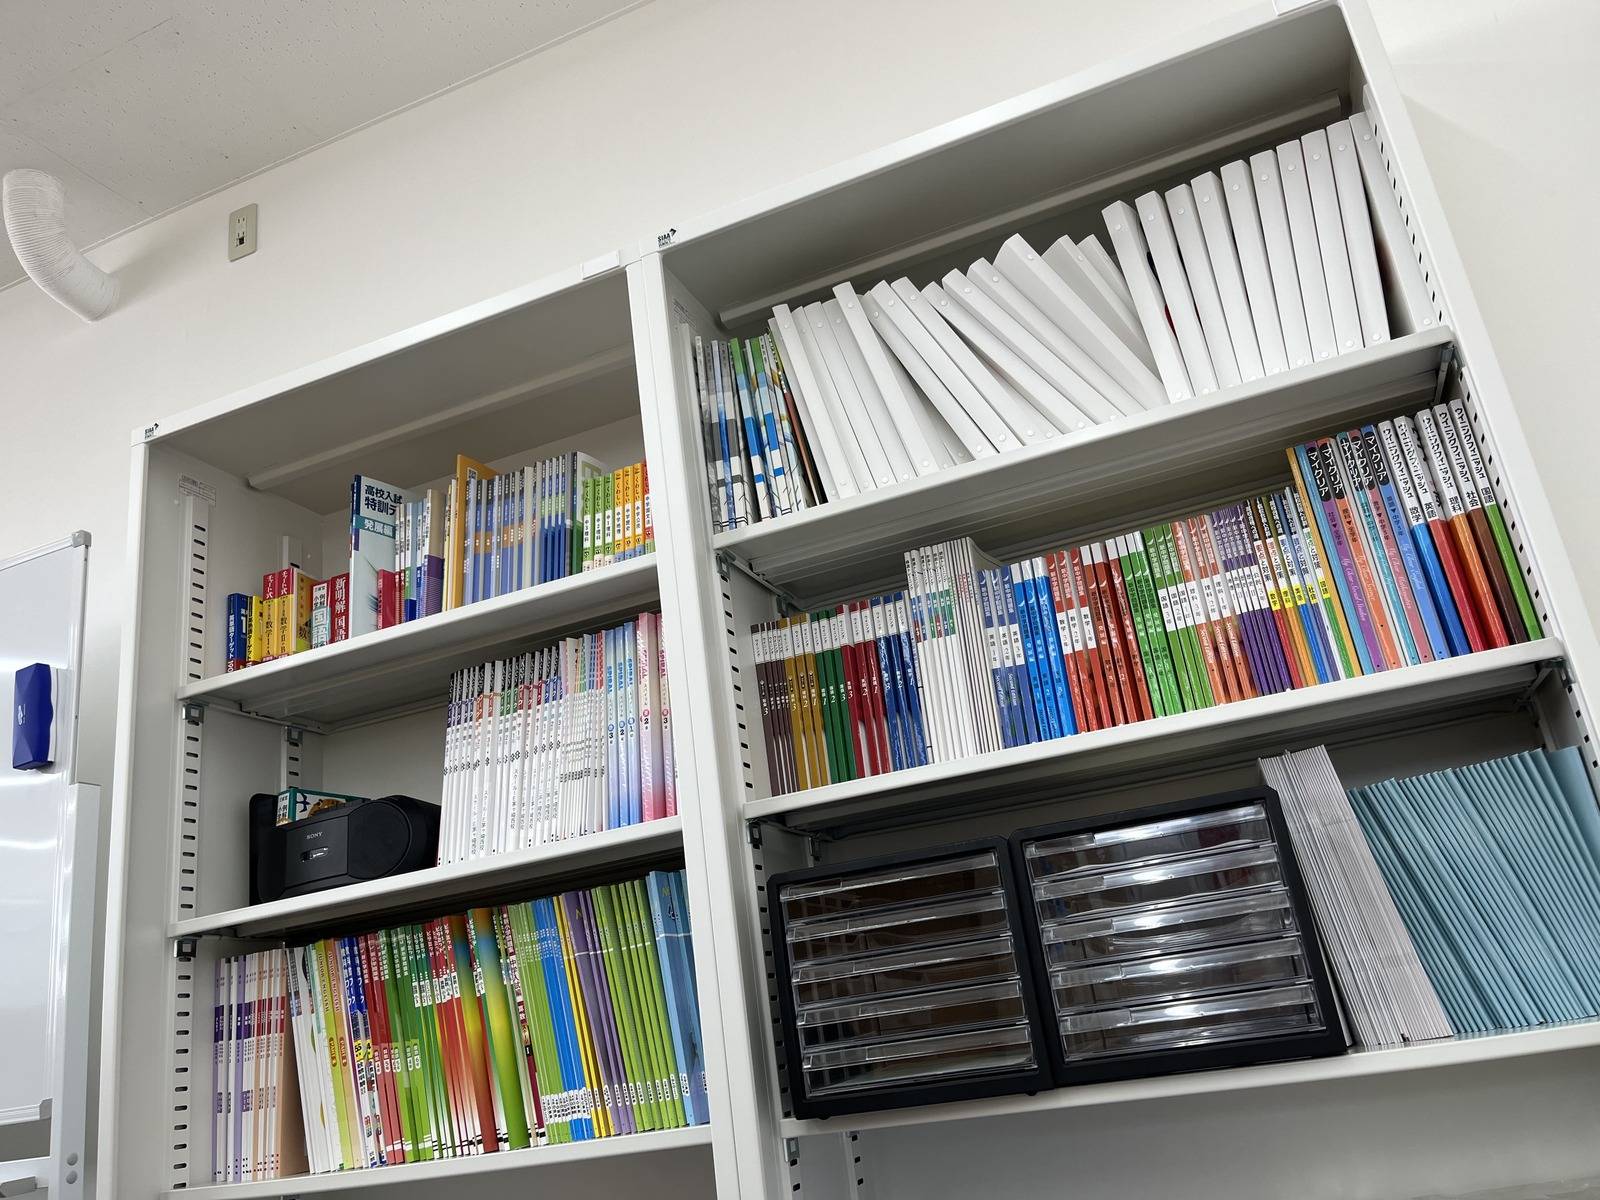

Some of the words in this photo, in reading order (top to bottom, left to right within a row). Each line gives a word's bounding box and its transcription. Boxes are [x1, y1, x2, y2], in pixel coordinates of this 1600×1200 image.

[1351, 438, 1372, 485] マイクリア
[1365, 434, 1387, 481] マイクリア
[1308, 450, 1329, 497] マイクリア
[1321, 446, 1342, 494] マイクリア
[365, 484, 402, 504] 高校入試
[1465, 490, 1479, 507] 社会
[1480, 486, 1494, 503] 国語
[1424, 501, 1438, 518] 英語
[1449, 495, 1463, 513] 理科
[1409, 506, 1423, 522] 数学
[335, 576, 346, 614] 新明解
[1204, 583, 1213, 598] 理科
[1215, 580, 1224, 595] 理科
[1160, 595, 1169, 609] 国語
[1171, 591, 1180, 606] 国語
[306, 832, 322, 840] SONY
